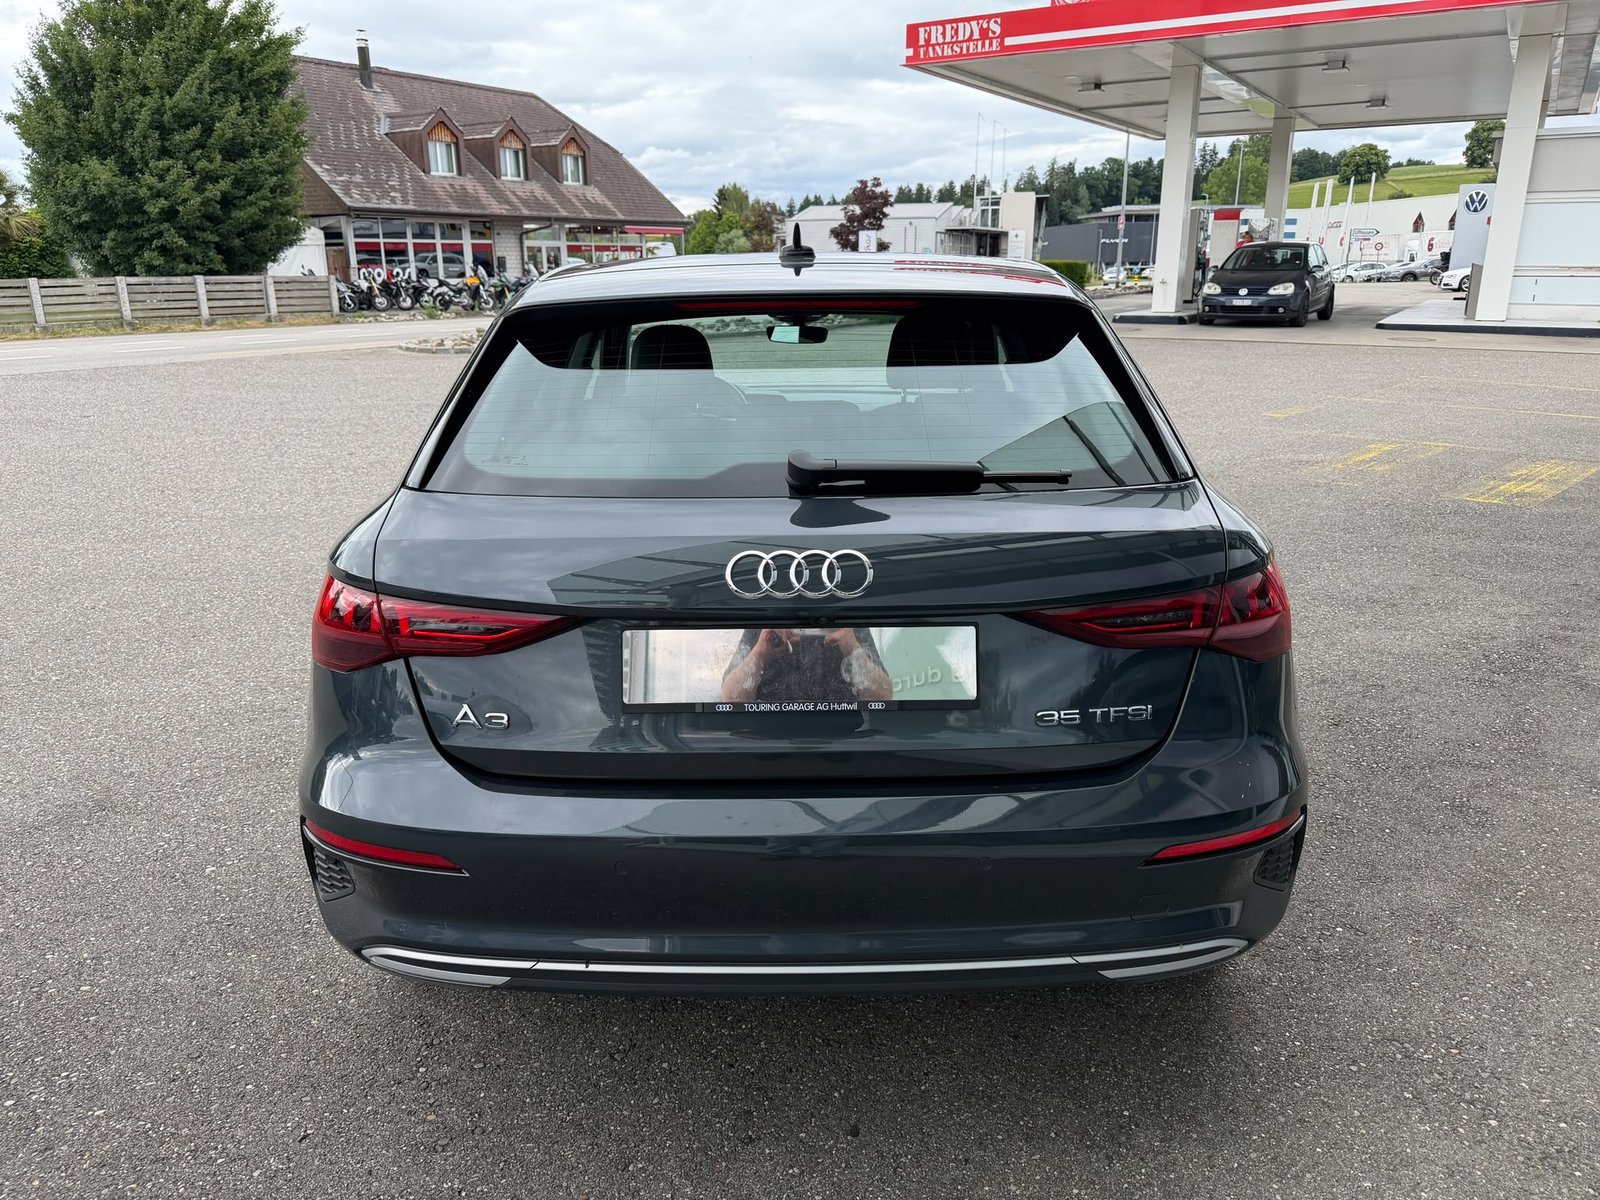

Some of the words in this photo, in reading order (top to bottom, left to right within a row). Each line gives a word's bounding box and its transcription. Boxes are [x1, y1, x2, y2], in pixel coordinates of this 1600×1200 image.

[918, 38, 1000, 59] TANKSTELLE
[452, 703, 509, 730] A3
[744, 703, 780, 712] TOURING
[782, 702, 815, 711] GARAGE
[816, 702, 829, 711] AG
[830, 701, 858, 711] Huttwil
[1035, 709, 1081, 727] 35
[1089, 704, 1153, 723] TFSI
